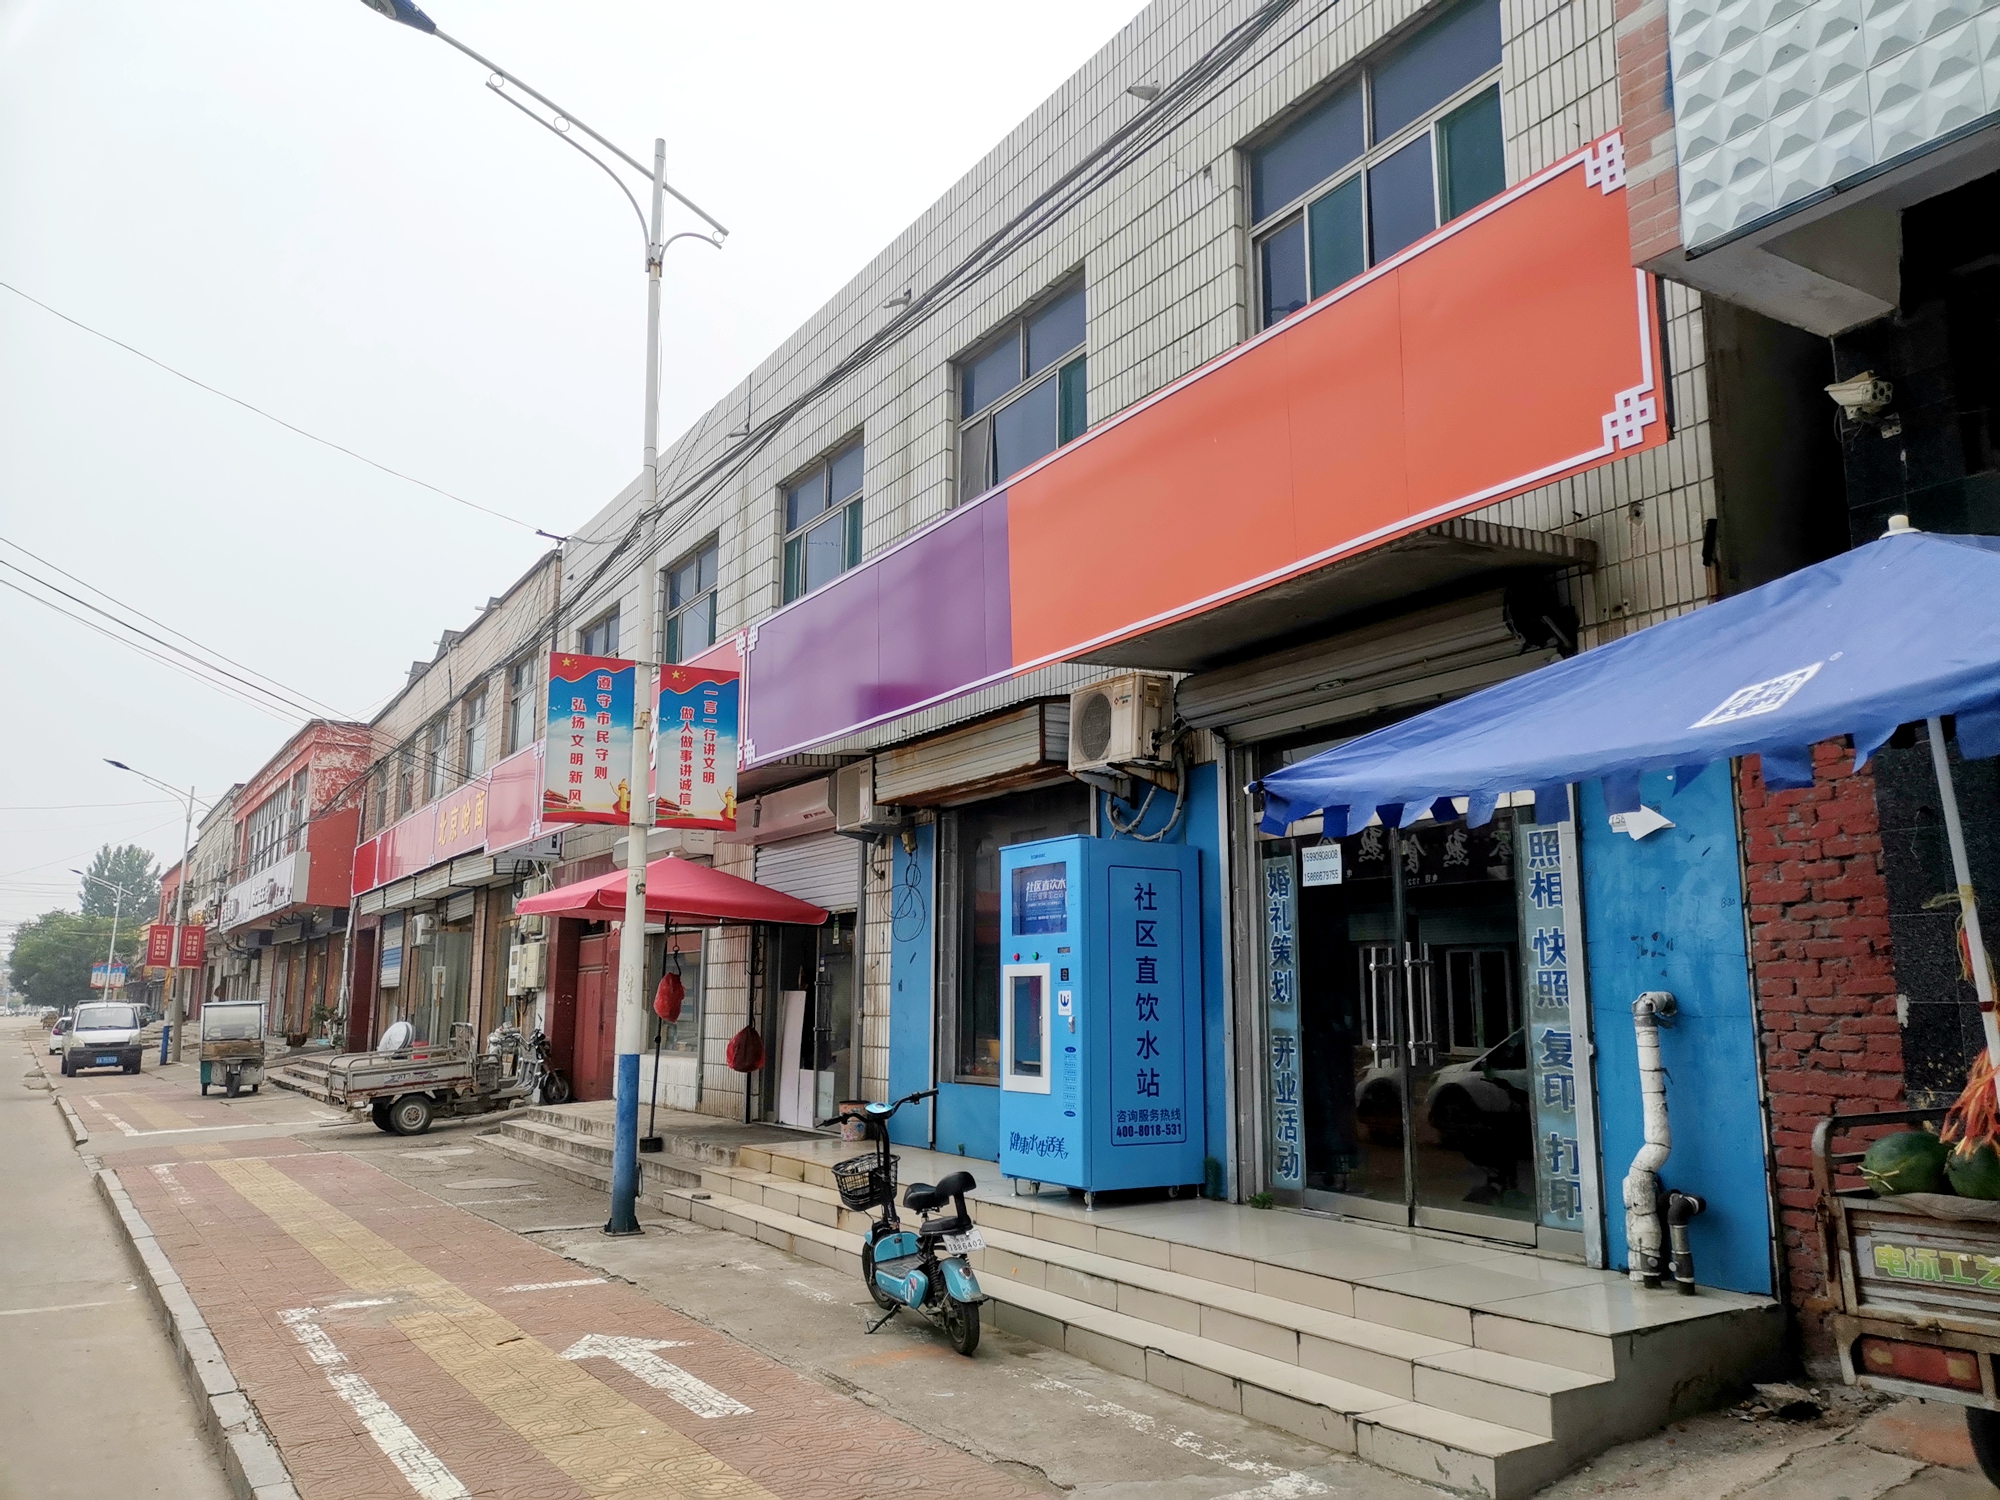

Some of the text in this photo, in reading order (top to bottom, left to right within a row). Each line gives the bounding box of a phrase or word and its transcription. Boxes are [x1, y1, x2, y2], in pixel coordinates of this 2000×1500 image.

[568, 697, 586, 803] 弘扬文明新风
[594, 675, 613, 780] 遵守市民守则
[679, 706, 695, 806] 做人做事讲诚信
[702, 689, 719, 785] 一言一行讲文明
[1134, 882, 1160, 1098] 社区直饮水站
[1267, 866, 1300, 1181] 婚礼策划 开业活动
[1527, 830, 1582, 1220] 照相 快照 复印 打印
[1116, 1108, 1181, 1123] 咨询服务热线
[1116, 1123, 1182, 1138] 400-8018-531
[949, 1238, 983, 1251] 1886402
